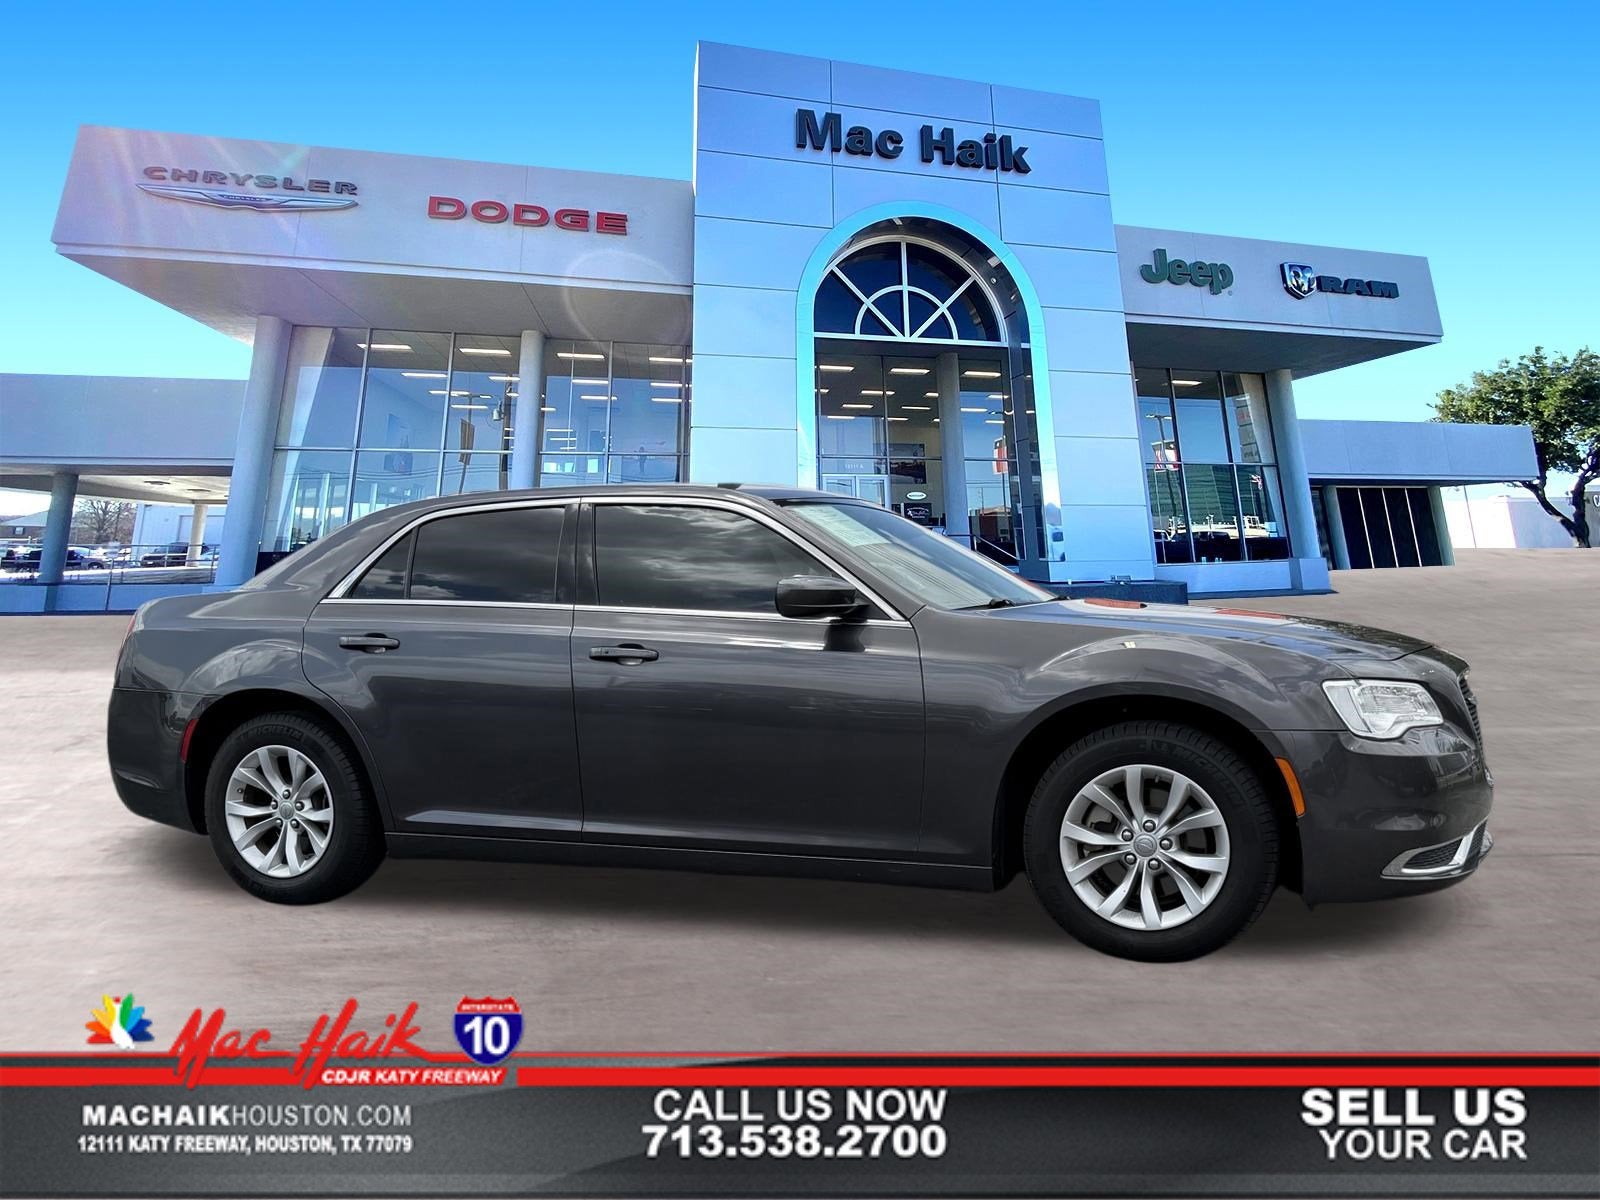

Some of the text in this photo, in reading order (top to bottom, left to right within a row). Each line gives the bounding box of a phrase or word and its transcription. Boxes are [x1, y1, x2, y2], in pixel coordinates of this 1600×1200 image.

[796, 108, 1032, 174] Mac Haik
[143, 166, 358, 196] CHRYSLER
[428, 195, 628, 236] DODGE
[1140, 248, 1234, 295] Jeep
[1316, 275, 1399, 299] RAM
